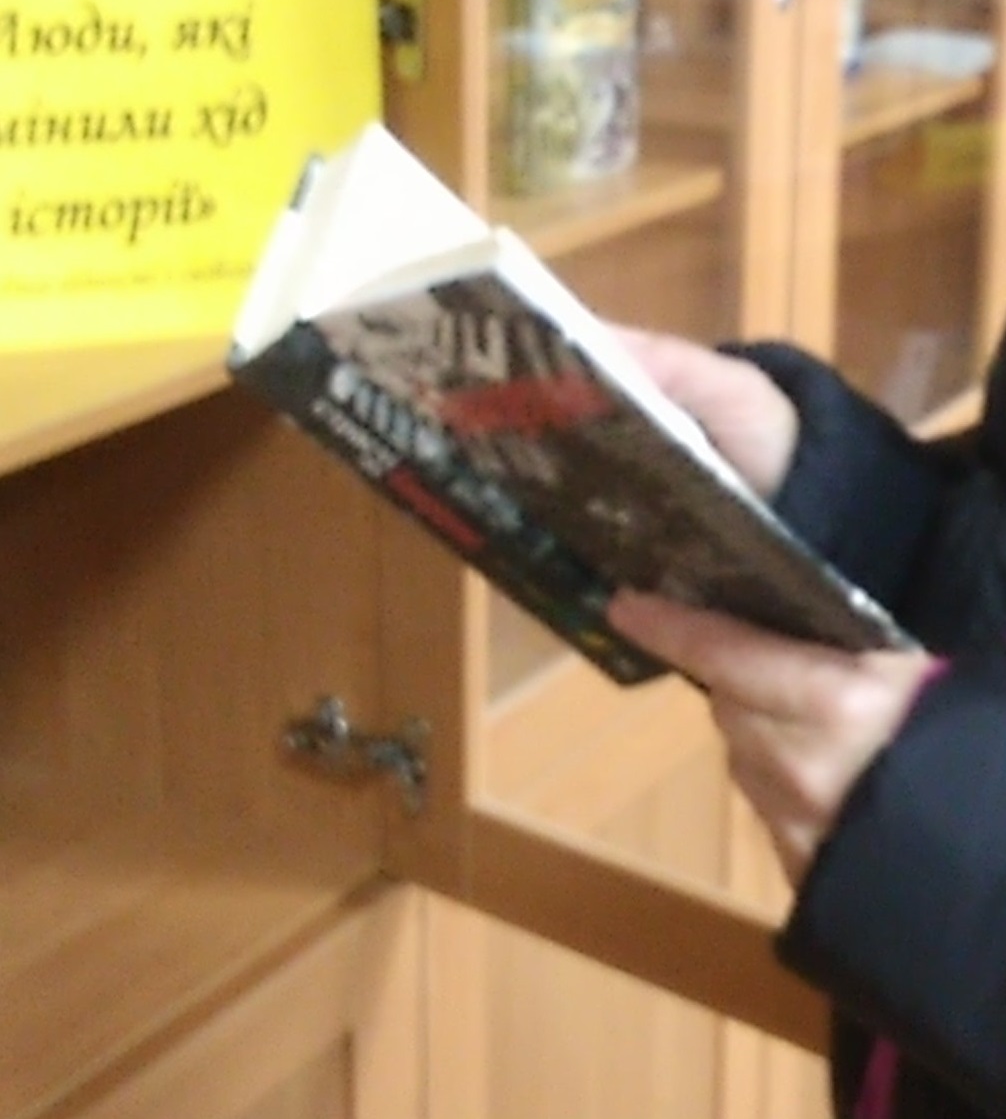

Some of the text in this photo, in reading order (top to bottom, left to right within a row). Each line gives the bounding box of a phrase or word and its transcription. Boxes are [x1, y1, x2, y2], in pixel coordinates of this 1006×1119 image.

[172, 0, 254, 63] які
[191, 82, 267, 149] хід
[10, 179, 217, 246] історії»
